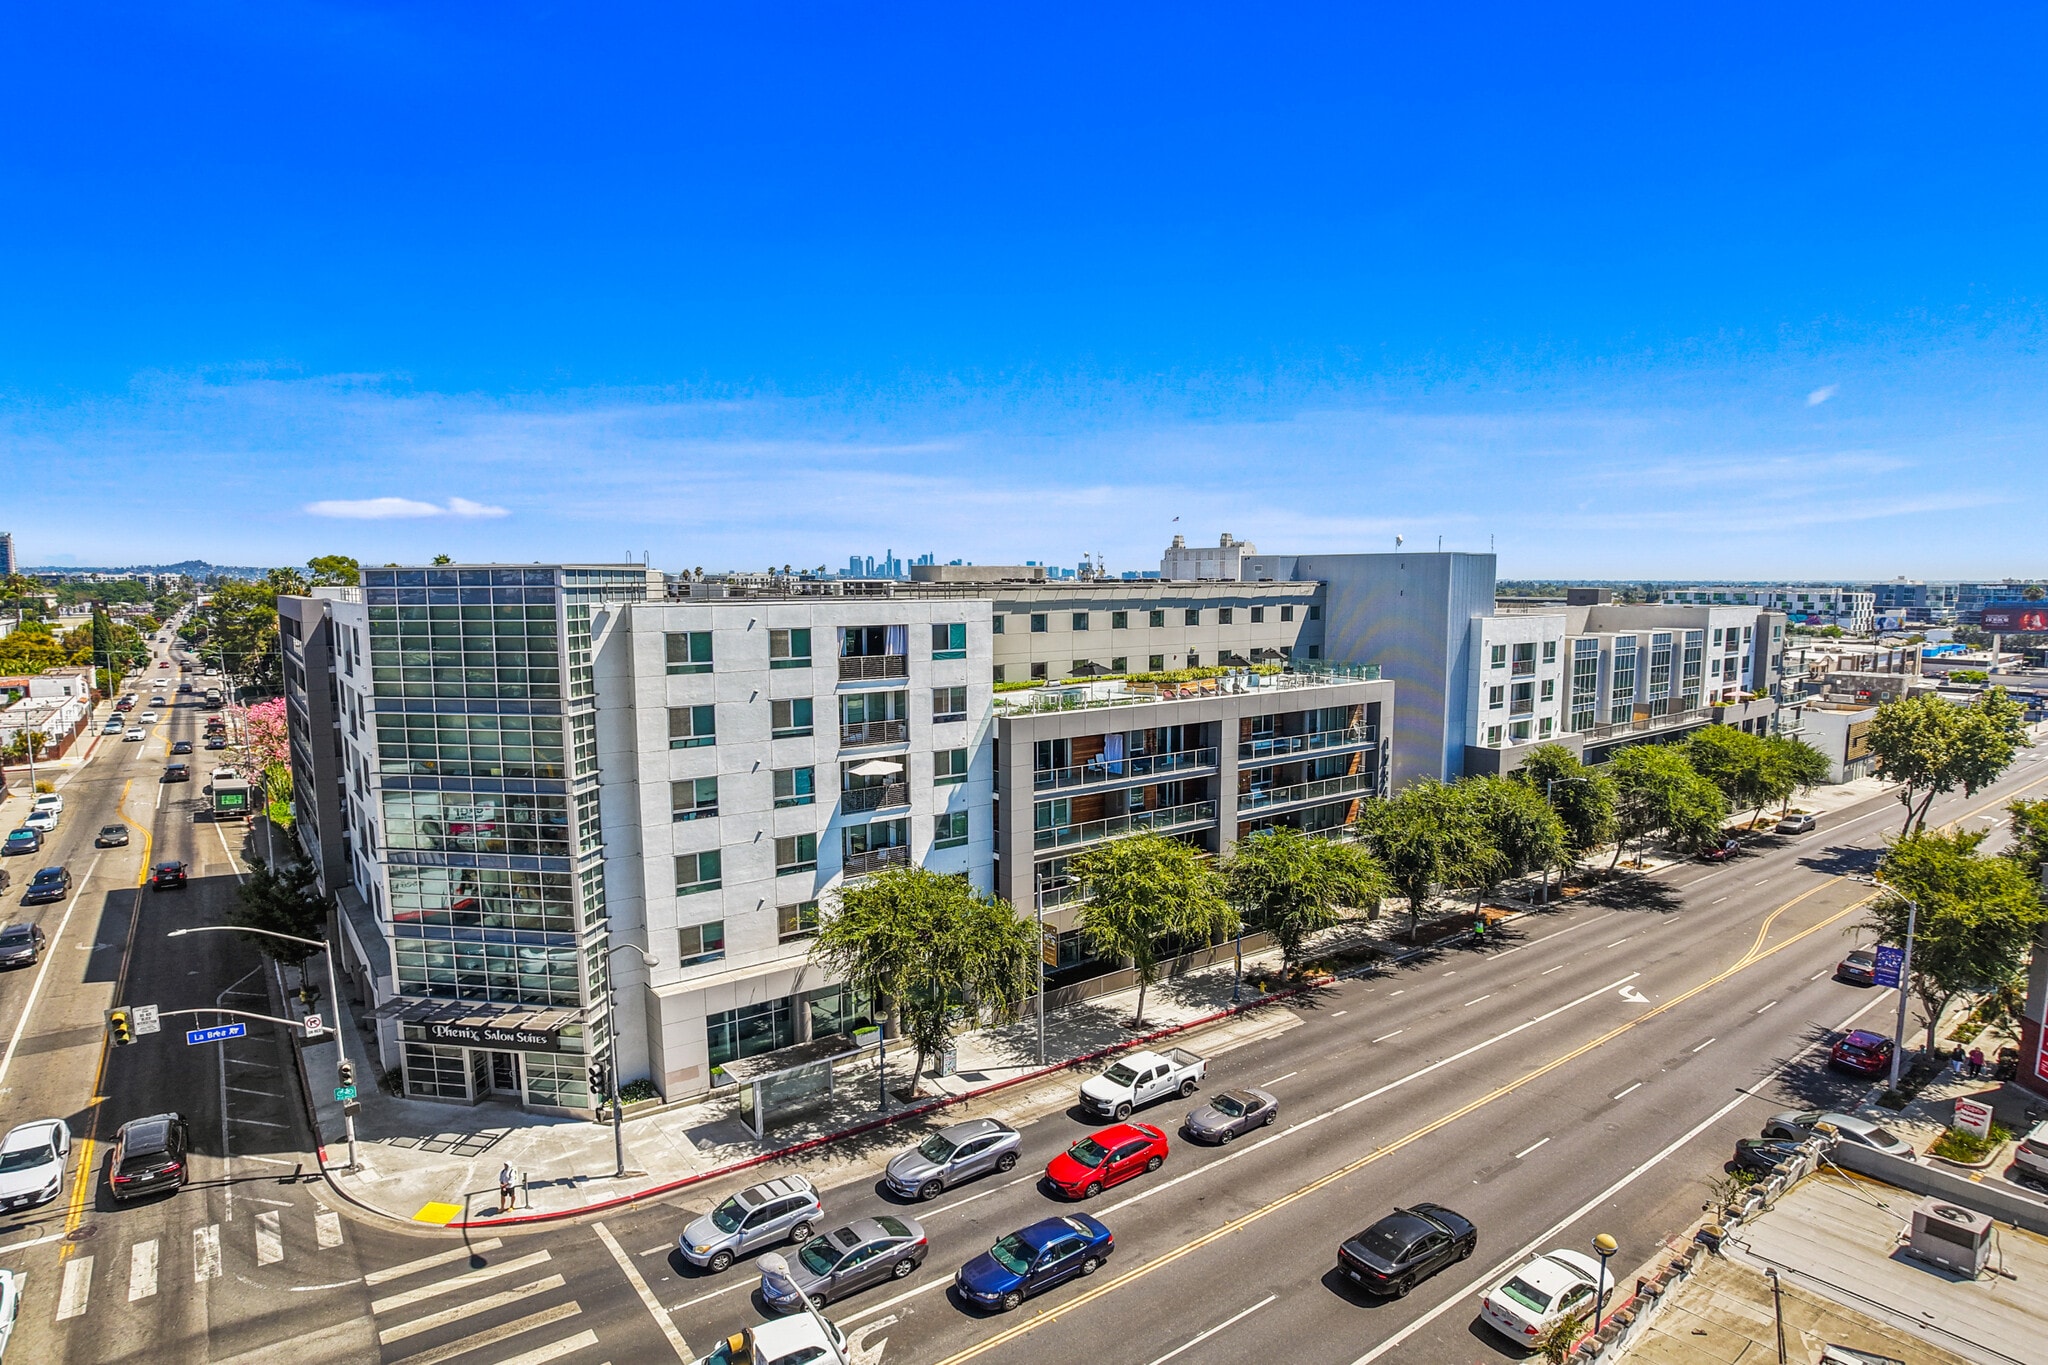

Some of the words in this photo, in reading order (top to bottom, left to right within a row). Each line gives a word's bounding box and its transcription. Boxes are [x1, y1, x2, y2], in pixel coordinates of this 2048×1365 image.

[194, 1033, 205, 1041] La
[207, 1029, 226, 1039] Brea
[431, 1025, 480, 1041] Phenix
